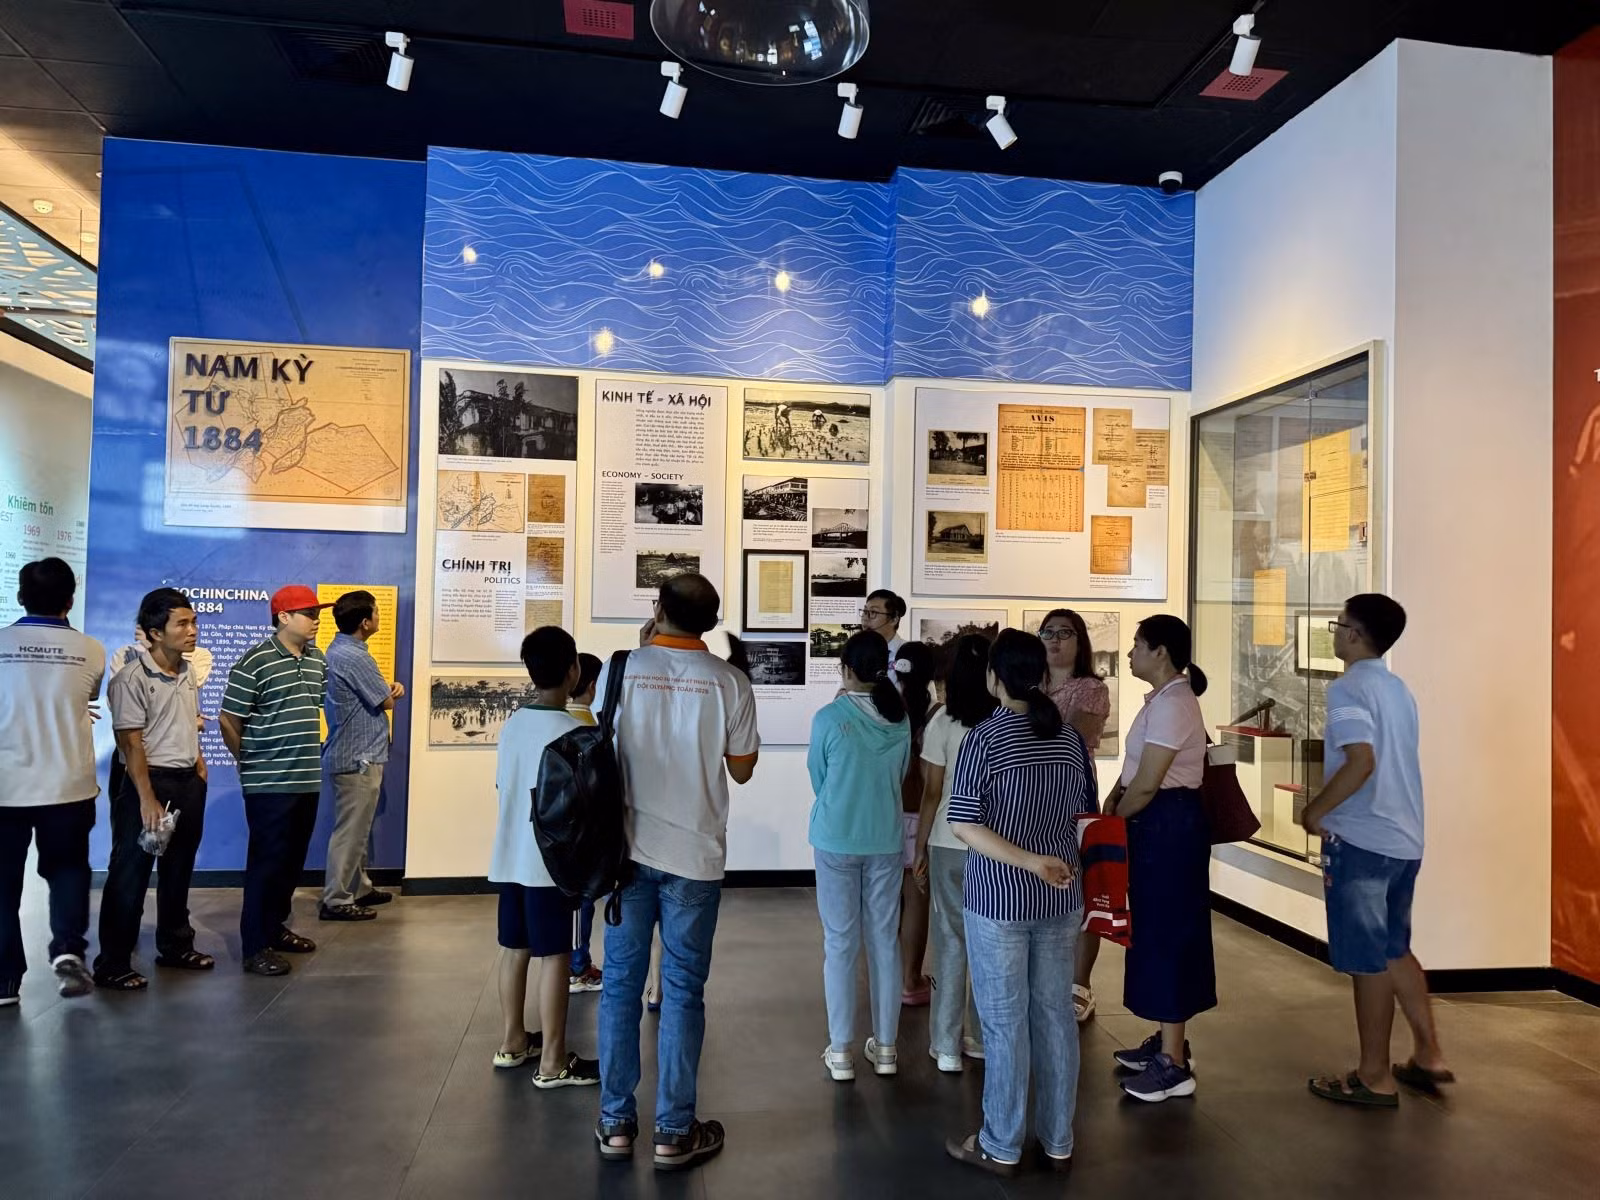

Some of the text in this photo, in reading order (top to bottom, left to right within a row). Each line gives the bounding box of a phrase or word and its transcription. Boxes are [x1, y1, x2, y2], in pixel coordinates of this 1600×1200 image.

[186, 352, 258, 380] NAM
[271, 353, 314, 384] KỲ
[182, 385, 231, 415] TỪ
[602, 390, 632, 403] KINH
[637, 390, 654, 404] TẾ
[668, 393, 684, 405] XÃ
[689, 394, 711, 410] HỘI
[183, 426, 262, 453] 1884
[602, 470, 641, 479] ECONOMY
[651, 473, 684, 481] SOCIETY
[7, 494, 54, 516] Khiêm tốn
[23, 524, 41, 537] 1969
[56, 530, 72, 542] 1976
[442, 557, 511, 575] CHÍNH TRỊ
[484, 576, 521, 585] POLITICS
[190, 602, 223, 613] 1884
[19, 646, 64, 655] HCMUTE
